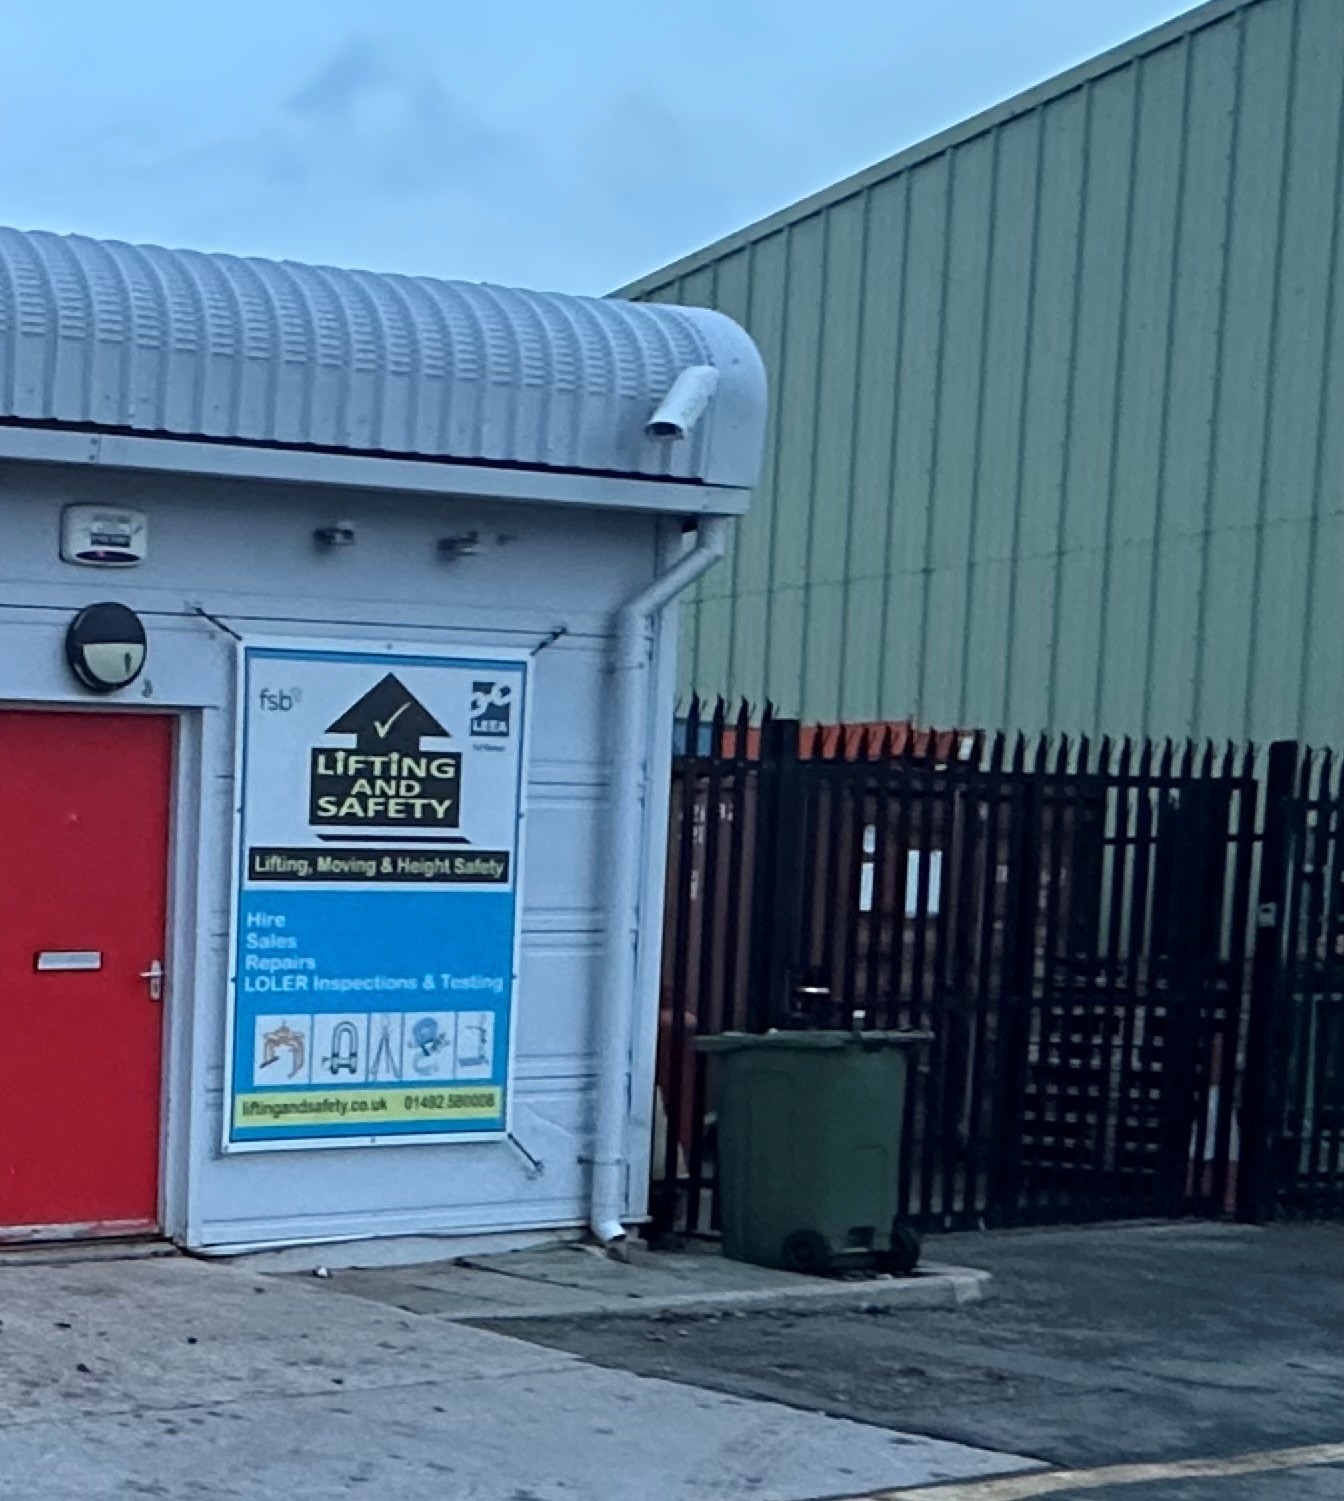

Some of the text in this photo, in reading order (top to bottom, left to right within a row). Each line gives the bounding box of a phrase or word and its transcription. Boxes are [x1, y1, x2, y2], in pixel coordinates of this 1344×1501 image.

[259, 688, 293, 711] fsb
[316, 751, 456, 779] LIFTING
[350, 779, 421, 797] AND
[316, 797, 452, 819] SAFETY
[254, 855, 505, 879] Lifting, Moving & Height Safety
[246, 911, 286, 929] Hire
[246, 933, 298, 949] Sales
[245, 955, 316, 974] Repairs
[244, 974, 504, 993] LOLER Inspections & Testing
[242, 1096, 388, 1119] liftingandsafety.co.uk
